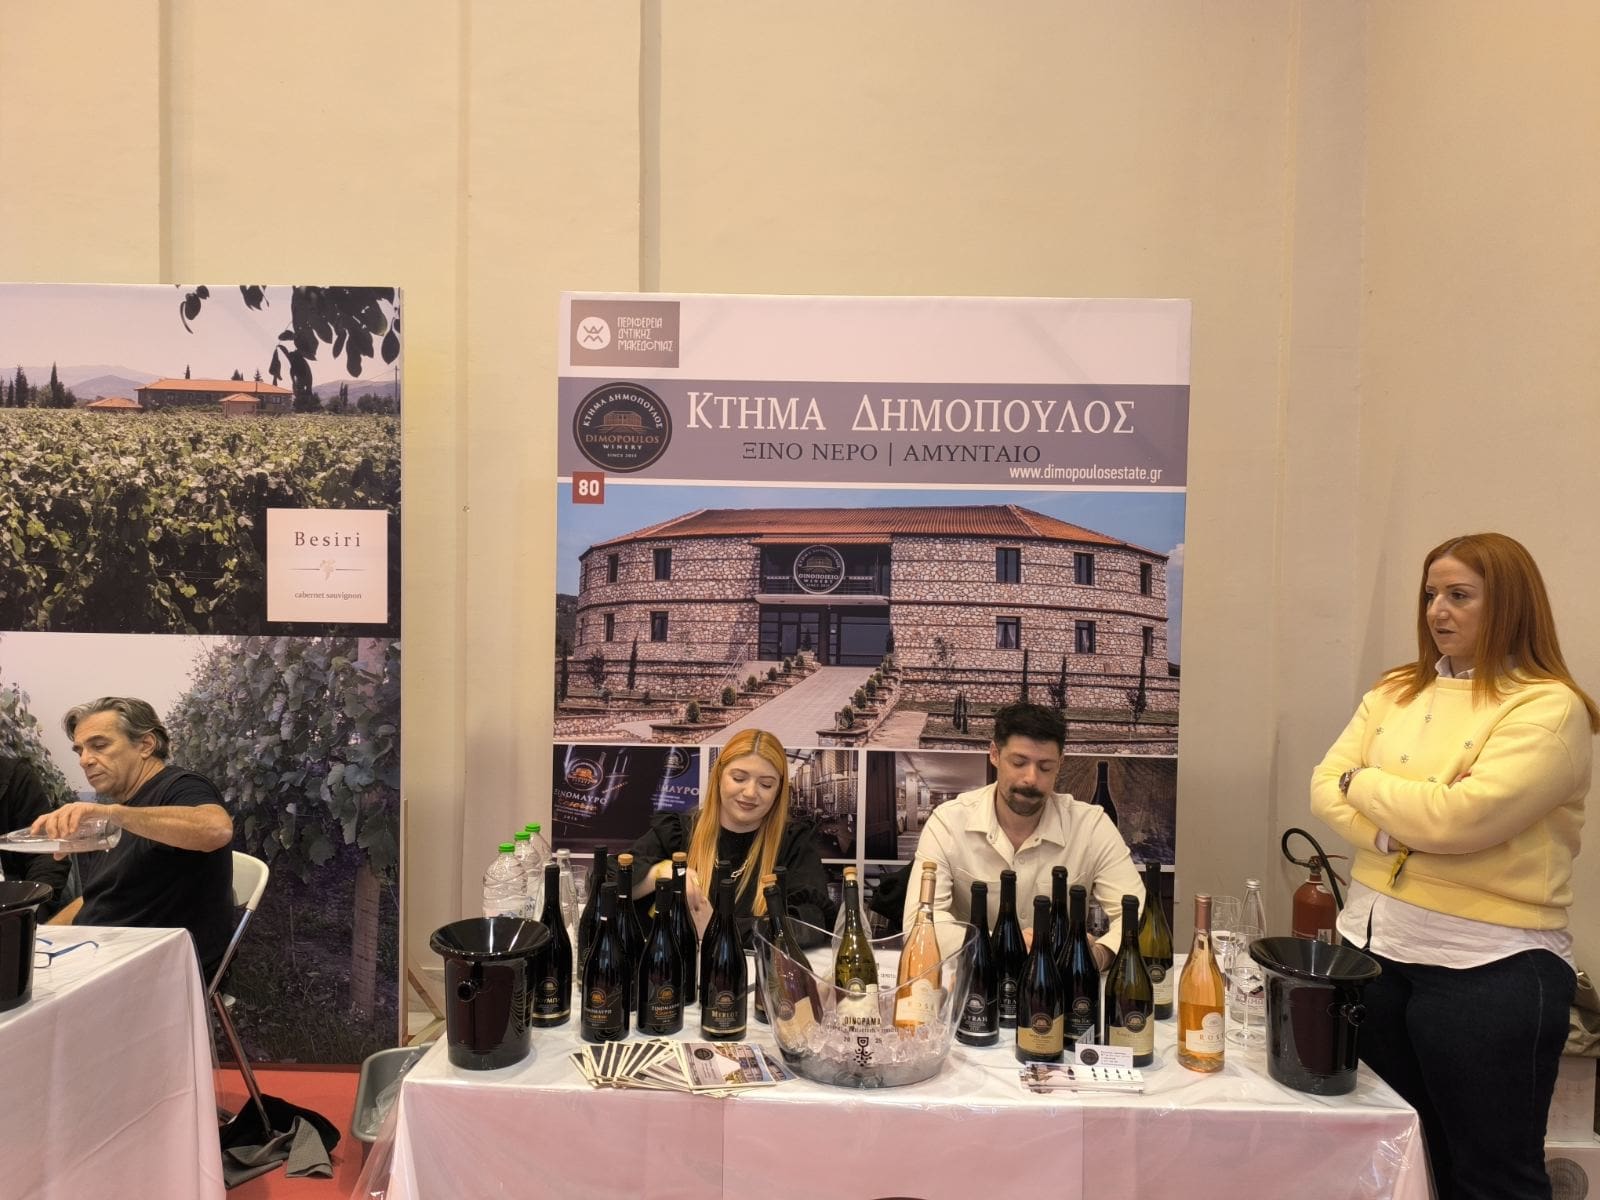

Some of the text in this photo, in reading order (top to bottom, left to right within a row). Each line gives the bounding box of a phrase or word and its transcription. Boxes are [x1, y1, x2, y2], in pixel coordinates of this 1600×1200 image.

[617, 316, 663, 328] ΠΕΡΙΦΕΡΕΙΑ
[618, 328, 652, 340] ΔΥΤΙΚΗΣ
[617, 340, 673, 352] ΜΑΚΕΔΟΝΙΑΣ
[582, 393, 664, 429] ΚΤΗΜΑ ΔΗΜΟΠΟΥΛΟΣ
[686, 391, 1135, 434] ΚΤΗΜΑ ΔΗΜΟΠΟΥΛΟΣ
[585, 434, 660, 444] DIMOPOULOS
[742, 442, 803, 460] ΞΙΝΟ
[811, 443, 878, 461] ΝΕΡΟ
[903, 444, 1041, 463] ΑΜΥΝΤΑΙΟ
[1009, 464, 1163, 483] www.dimopoulosestate.gr
[578, 479, 600, 496] 80
[294, 531, 361, 547] Besiri
[294, 591, 362, 601] cabernet sauvignon
